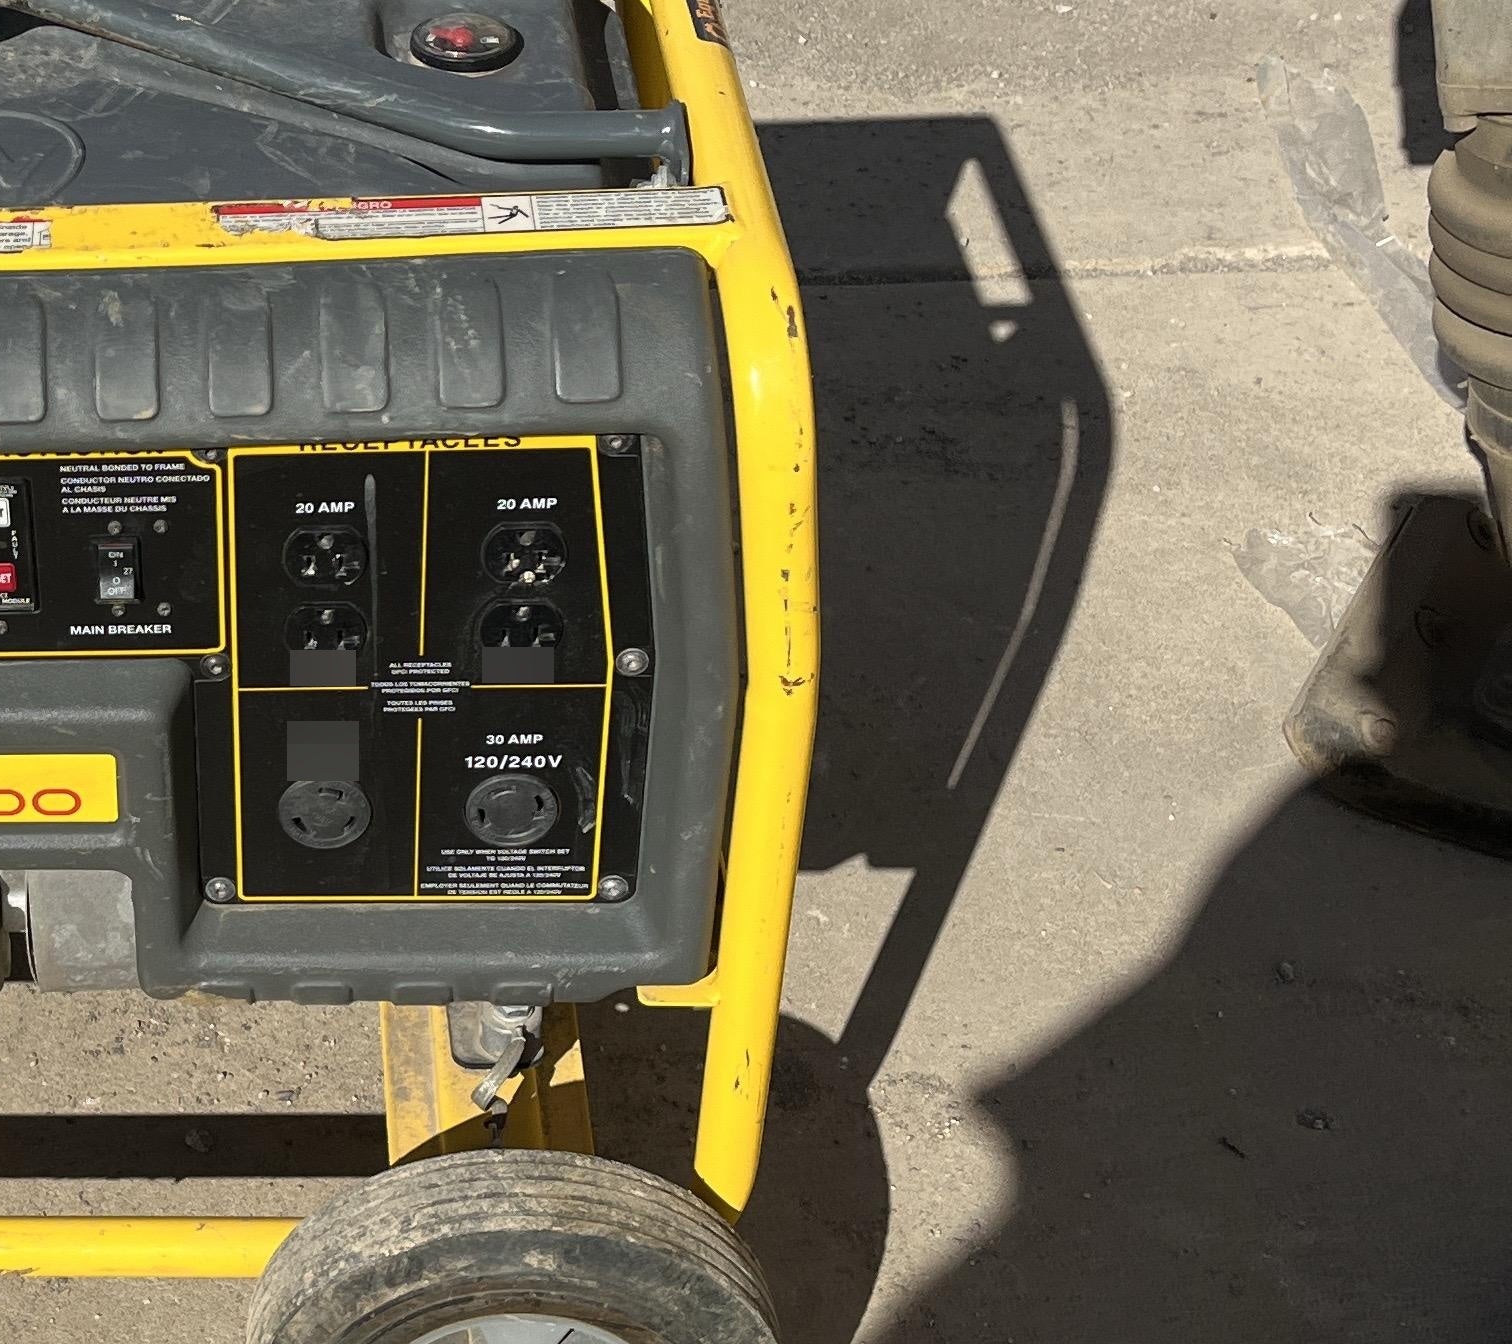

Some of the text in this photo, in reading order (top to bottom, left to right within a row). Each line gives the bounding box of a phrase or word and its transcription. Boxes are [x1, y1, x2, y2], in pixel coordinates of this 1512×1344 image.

[299, 437, 522, 451] RECEPTACLES
[295, 501, 355, 514] 20 AMP
[497, 497, 558, 510] 20 AMP
[108, 586, 126, 595] OFF
[70, 624, 171, 635] MAIN BREAKER
[486, 734, 544, 745] 30 AMP
[464, 755, 562, 769] 120/240V
